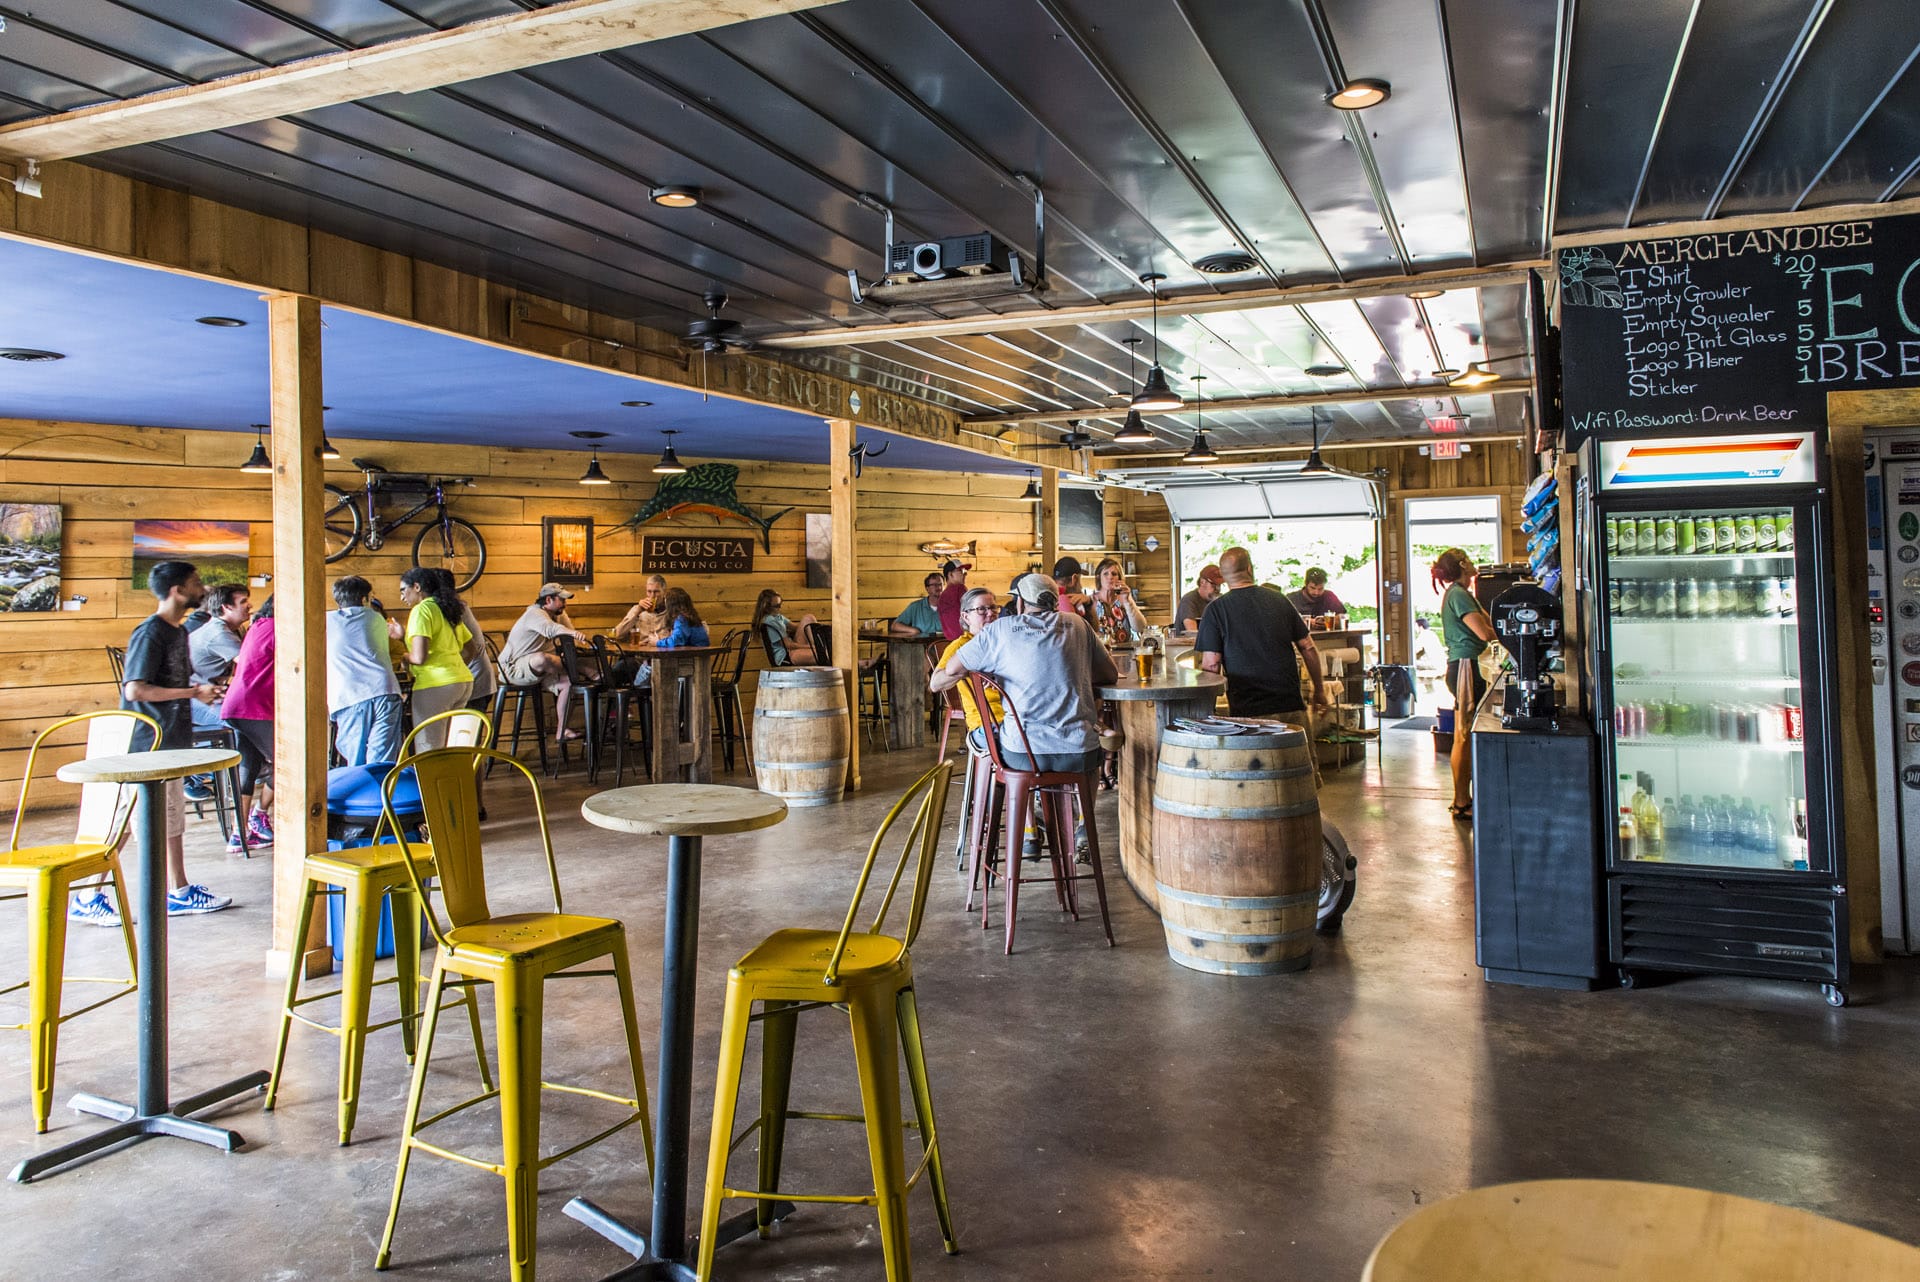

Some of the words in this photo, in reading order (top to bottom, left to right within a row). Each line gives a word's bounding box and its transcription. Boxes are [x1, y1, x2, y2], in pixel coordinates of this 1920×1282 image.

[1615, 222, 1873, 268] MERCHANDISE
[1620, 268, 1646, 289] T
[1648, 263, 1692, 287] Shirt
[1623, 289, 1681, 315] Empty
[1684, 282, 1752, 304] Growler
[1799, 273, 1815, 290] 7
[1623, 312, 1687, 338] Empty
[1691, 304, 1775, 331] Squealer
[1797, 299, 1813, 317] 5
[1624, 337, 1680, 358] Logo
[1685, 331, 1727, 351] Pint
[1730, 328, 1788, 347] Glass
[1798, 323, 1815, 341] 5
[1627, 357, 1679, 377] Logo
[1684, 351, 1744, 370] Pilsner
[1796, 345, 1812, 361] 5
[1629, 374, 1698, 397] Sticker
[1798, 364, 1815, 383] 1
[1571, 411, 1610, 431] Wifi
[1701, 406, 1751, 422] Drink
[1753, 405, 1799, 421] Beer
[1436, 441, 1457, 456] EXIT
[649, 560, 717, 569] BREWING
[651, 540, 748, 558] ECUSTA
